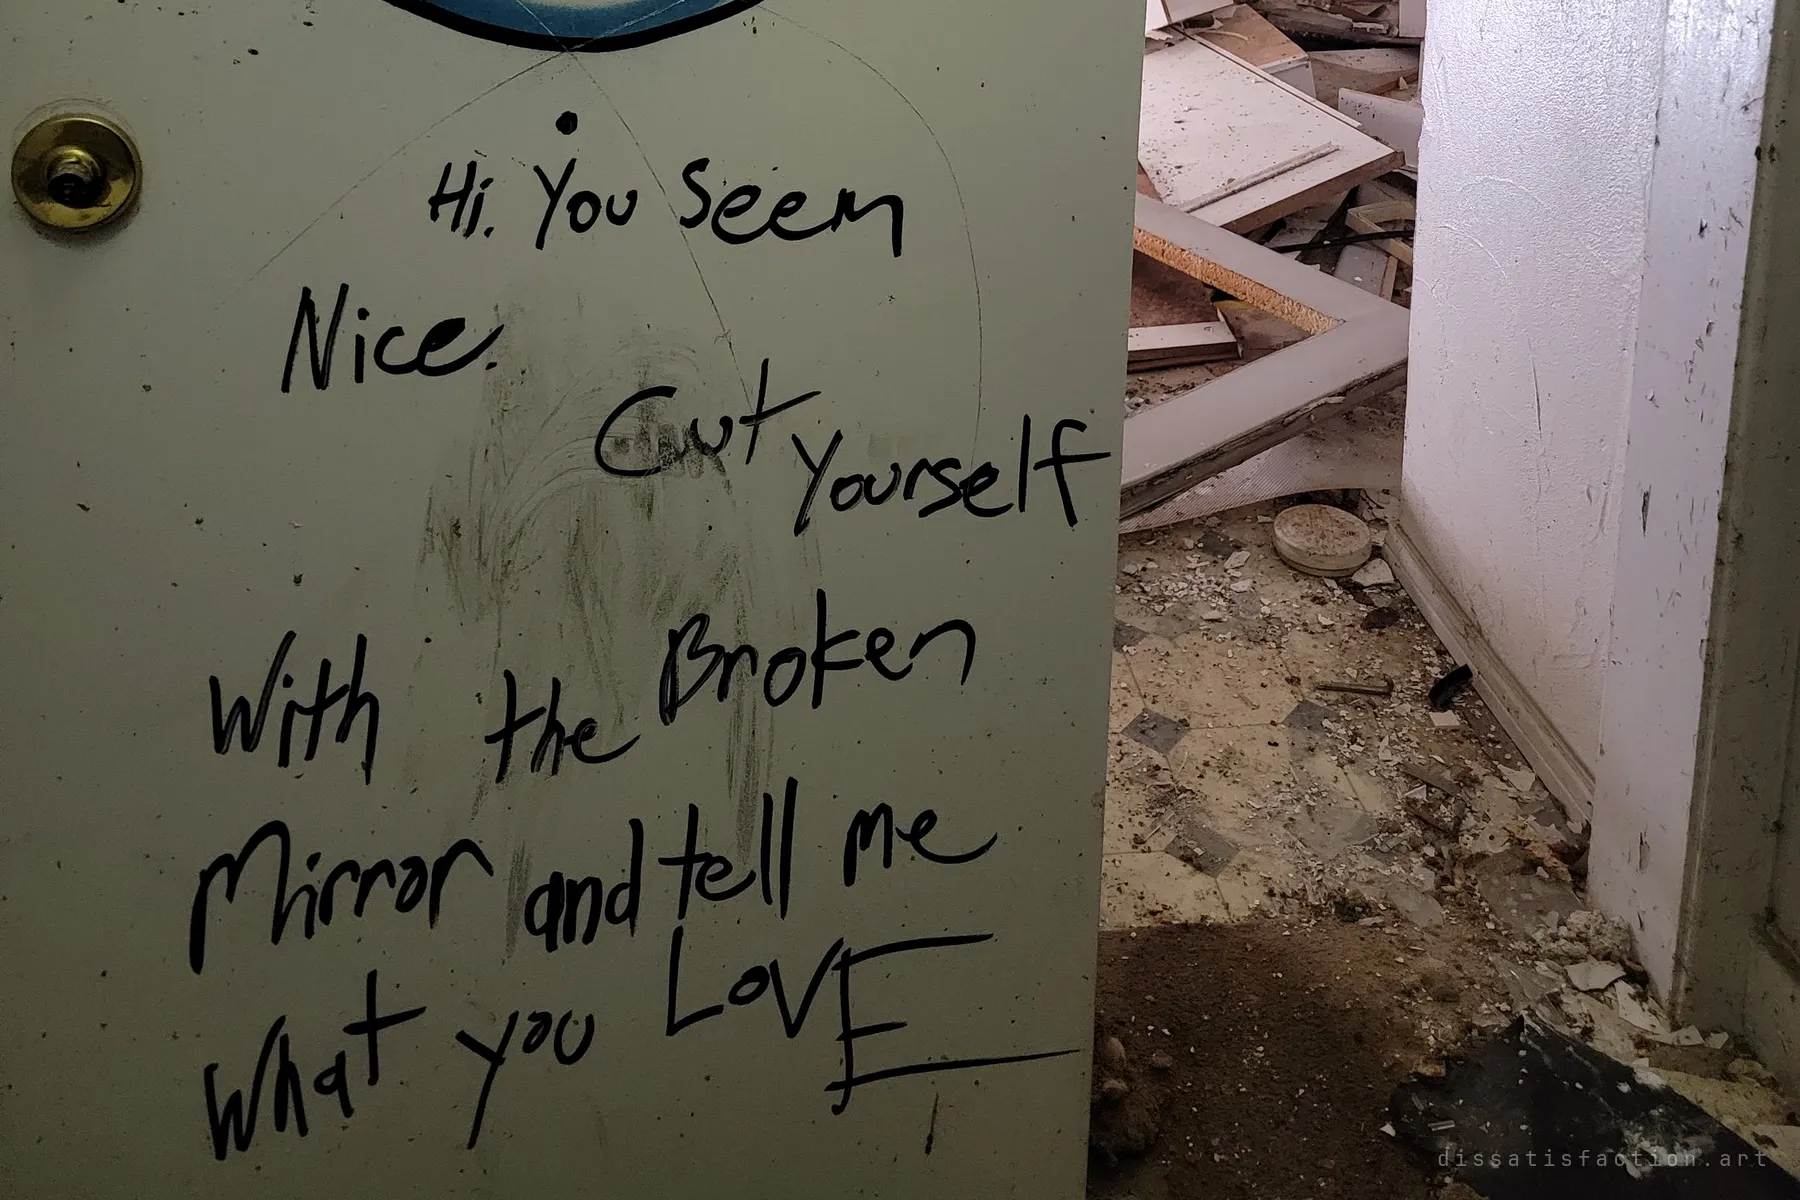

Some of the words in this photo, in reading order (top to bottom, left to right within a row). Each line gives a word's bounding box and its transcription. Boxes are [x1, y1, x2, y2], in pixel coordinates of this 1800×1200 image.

[533, 158, 637, 250] You
[679, 158, 903, 258] Seem
[594, 358, 821, 477] Cut
[208, 631, 379, 785] With
[485, 669, 641, 784] the
[659, 589, 976, 726] Broken
[190, 820, 493, 974] Mirror
[525, 818, 643, 953] and
[658, 777, 798, 920] tell
[204, 970, 426, 1160] What
